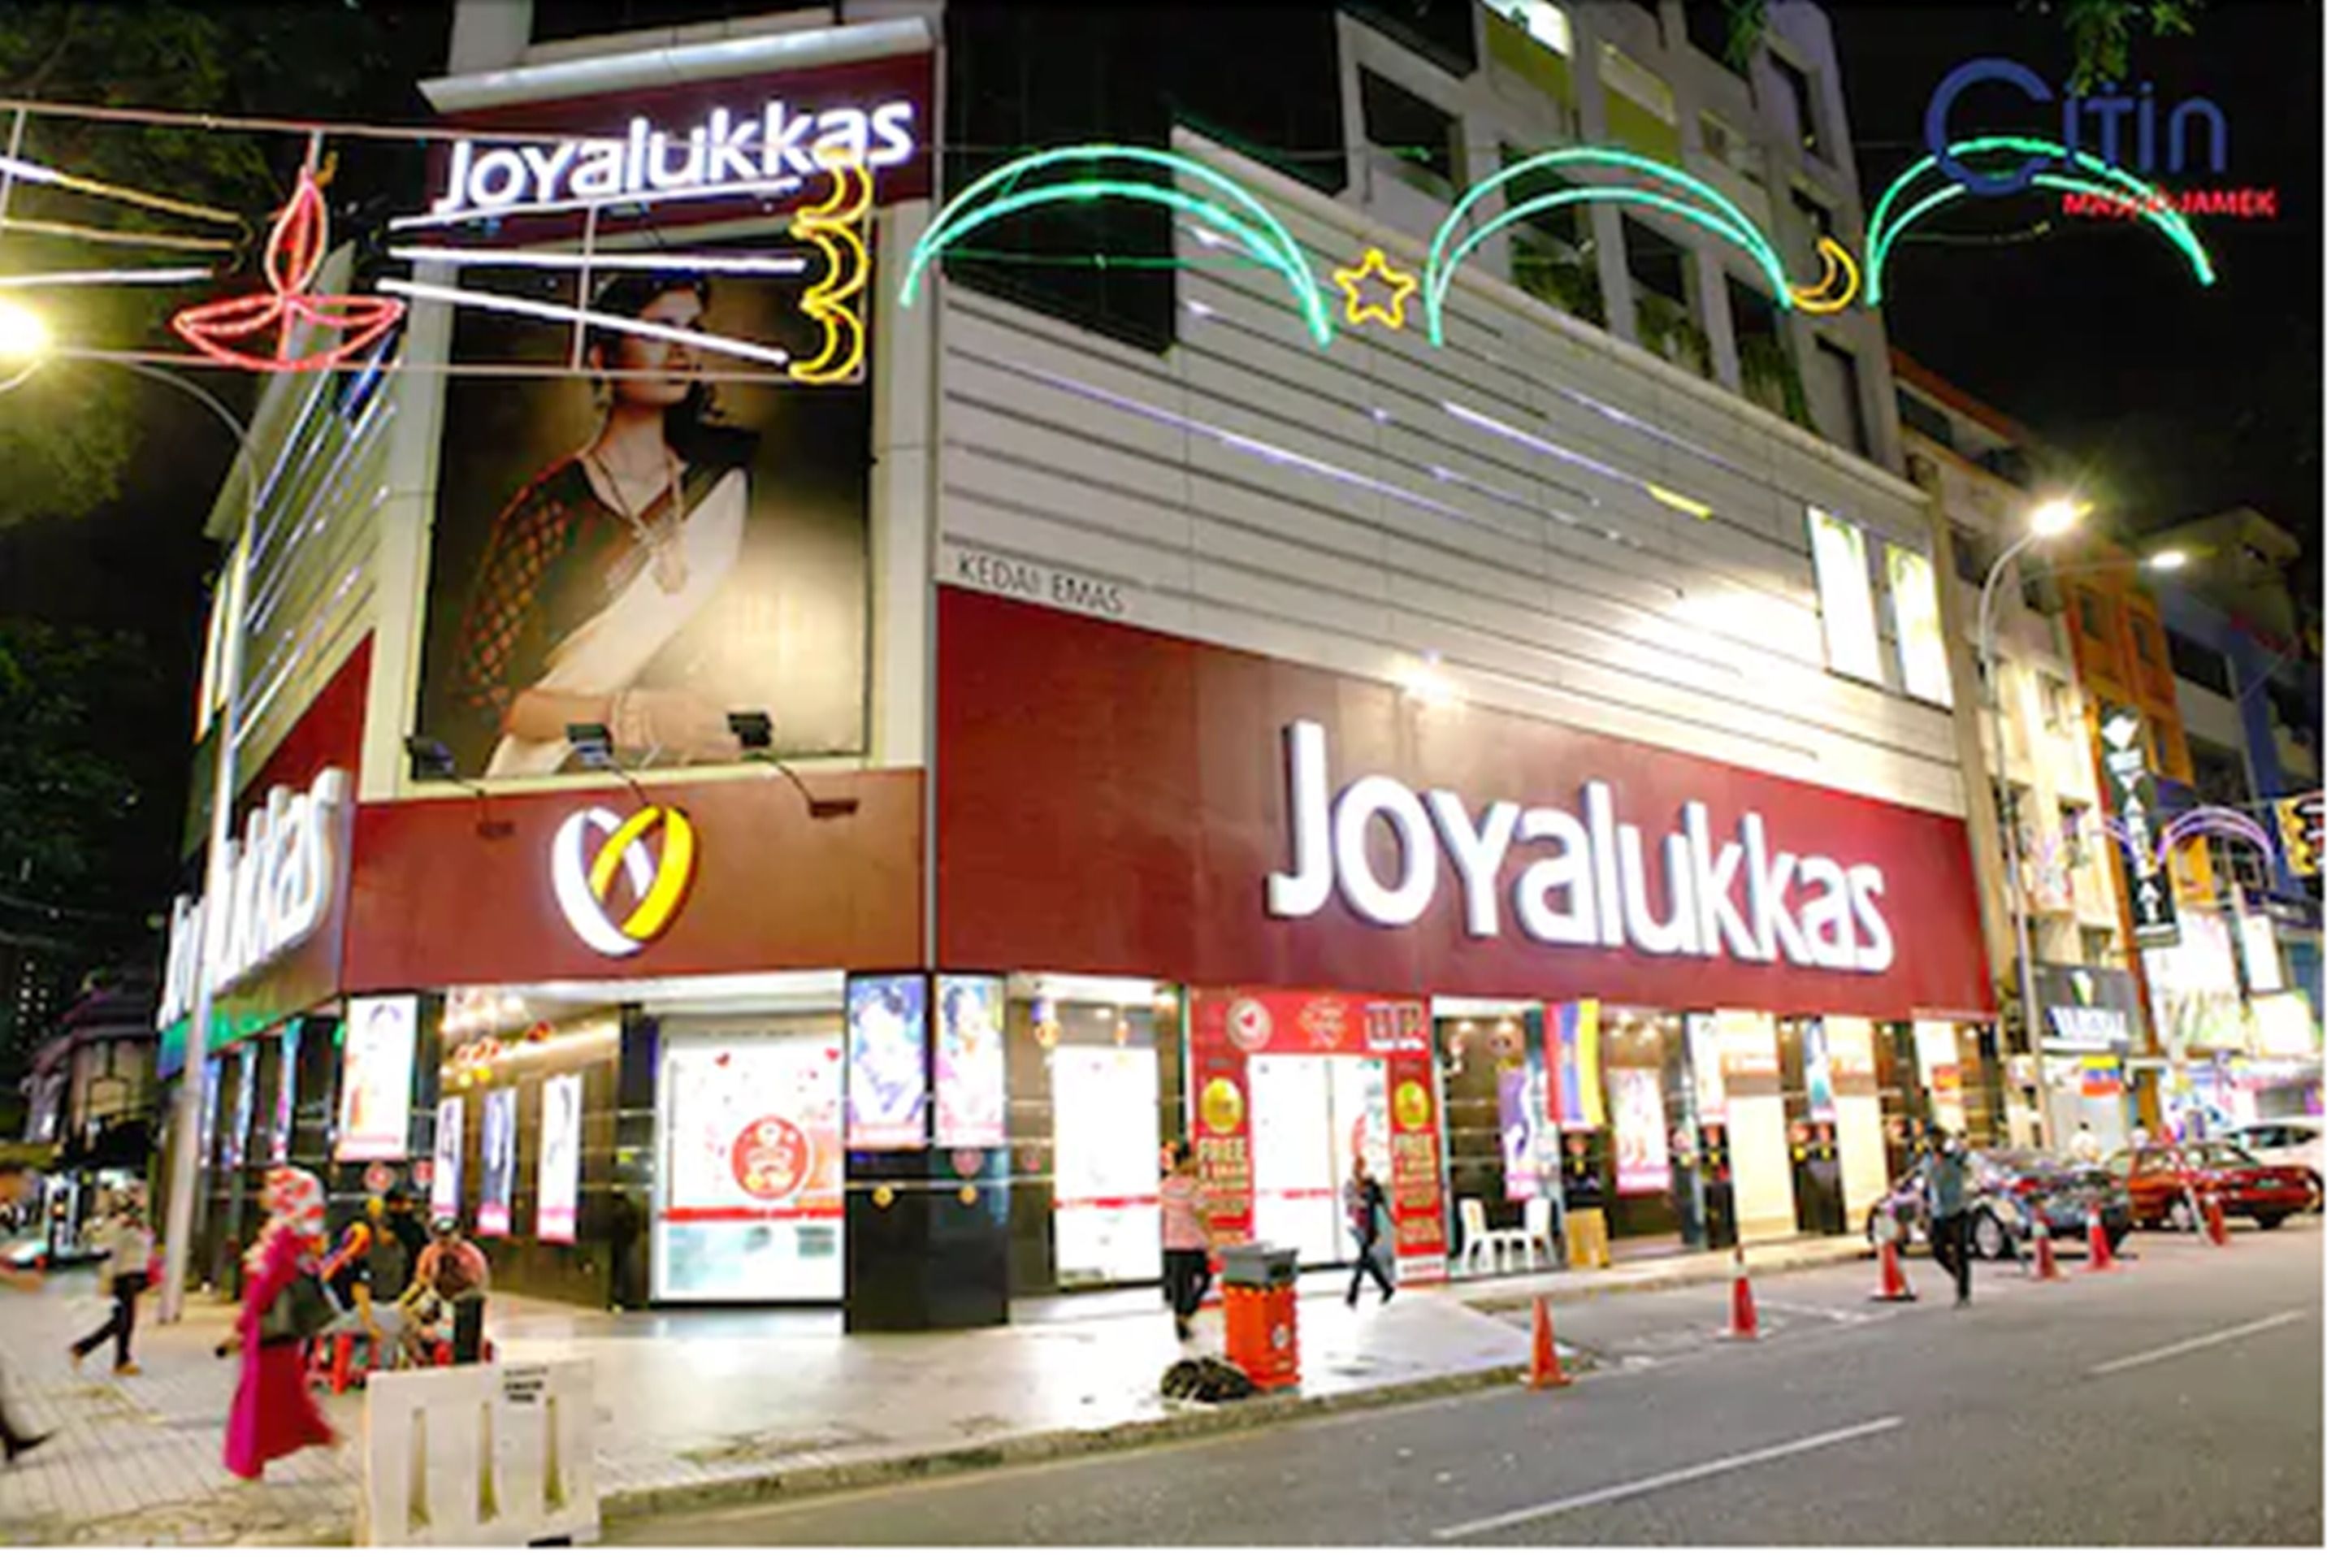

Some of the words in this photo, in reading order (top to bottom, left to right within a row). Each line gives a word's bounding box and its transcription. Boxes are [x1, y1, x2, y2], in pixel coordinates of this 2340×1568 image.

[431, 100, 913, 214] Joyalukkas
[958, 553, 1039, 595] KEDAI
[1052, 574, 1125, 614] EMAS
[1267, 719, 1896, 972] Joyalukkas
